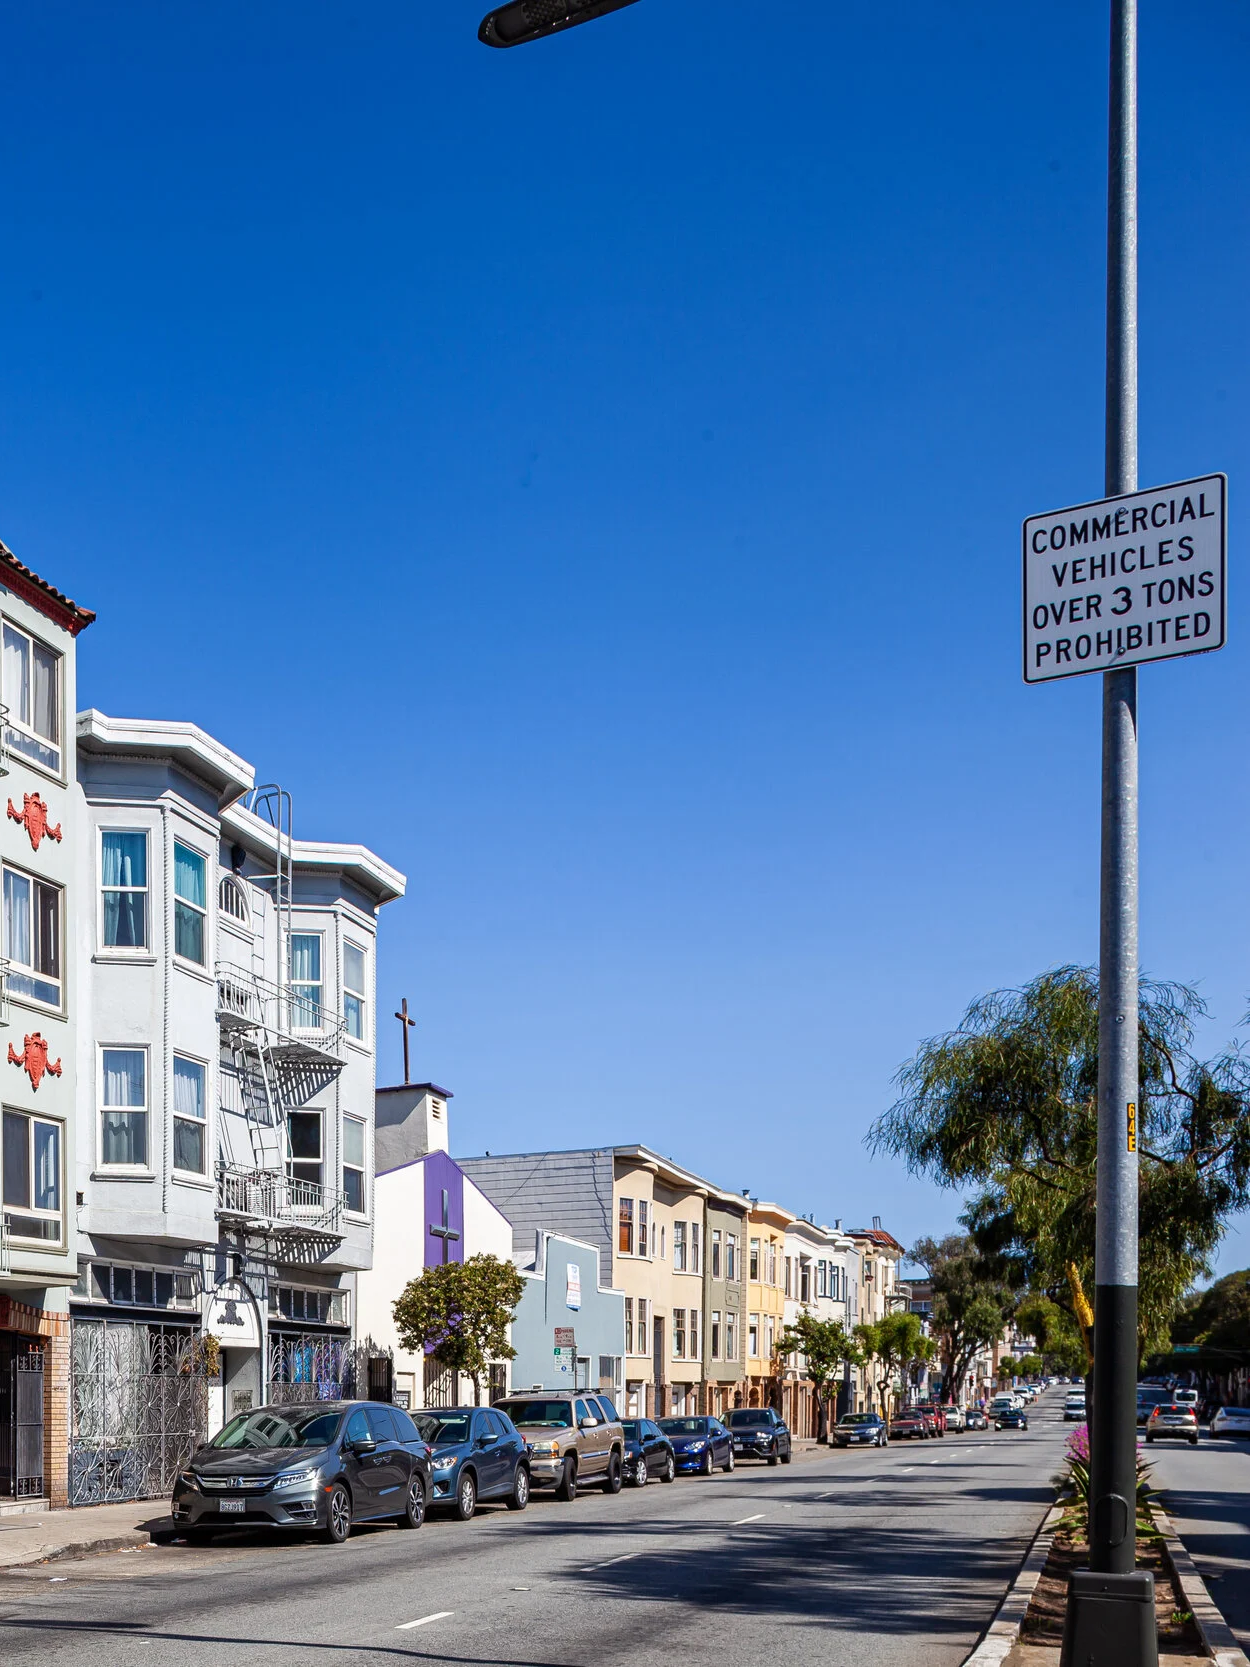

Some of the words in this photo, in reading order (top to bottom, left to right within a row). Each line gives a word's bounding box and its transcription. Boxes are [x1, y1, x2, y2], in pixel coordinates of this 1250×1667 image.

[1032, 493, 1215, 554] COMMERCIAL
[1052, 536, 1194, 587] VEHICLES
[1033, 594, 1102, 630] OVER
[1111, 586, 1132, 615] 3
[1142, 571, 1214, 608] TONS
[1036, 612, 1211, 668] PROHIBITED
